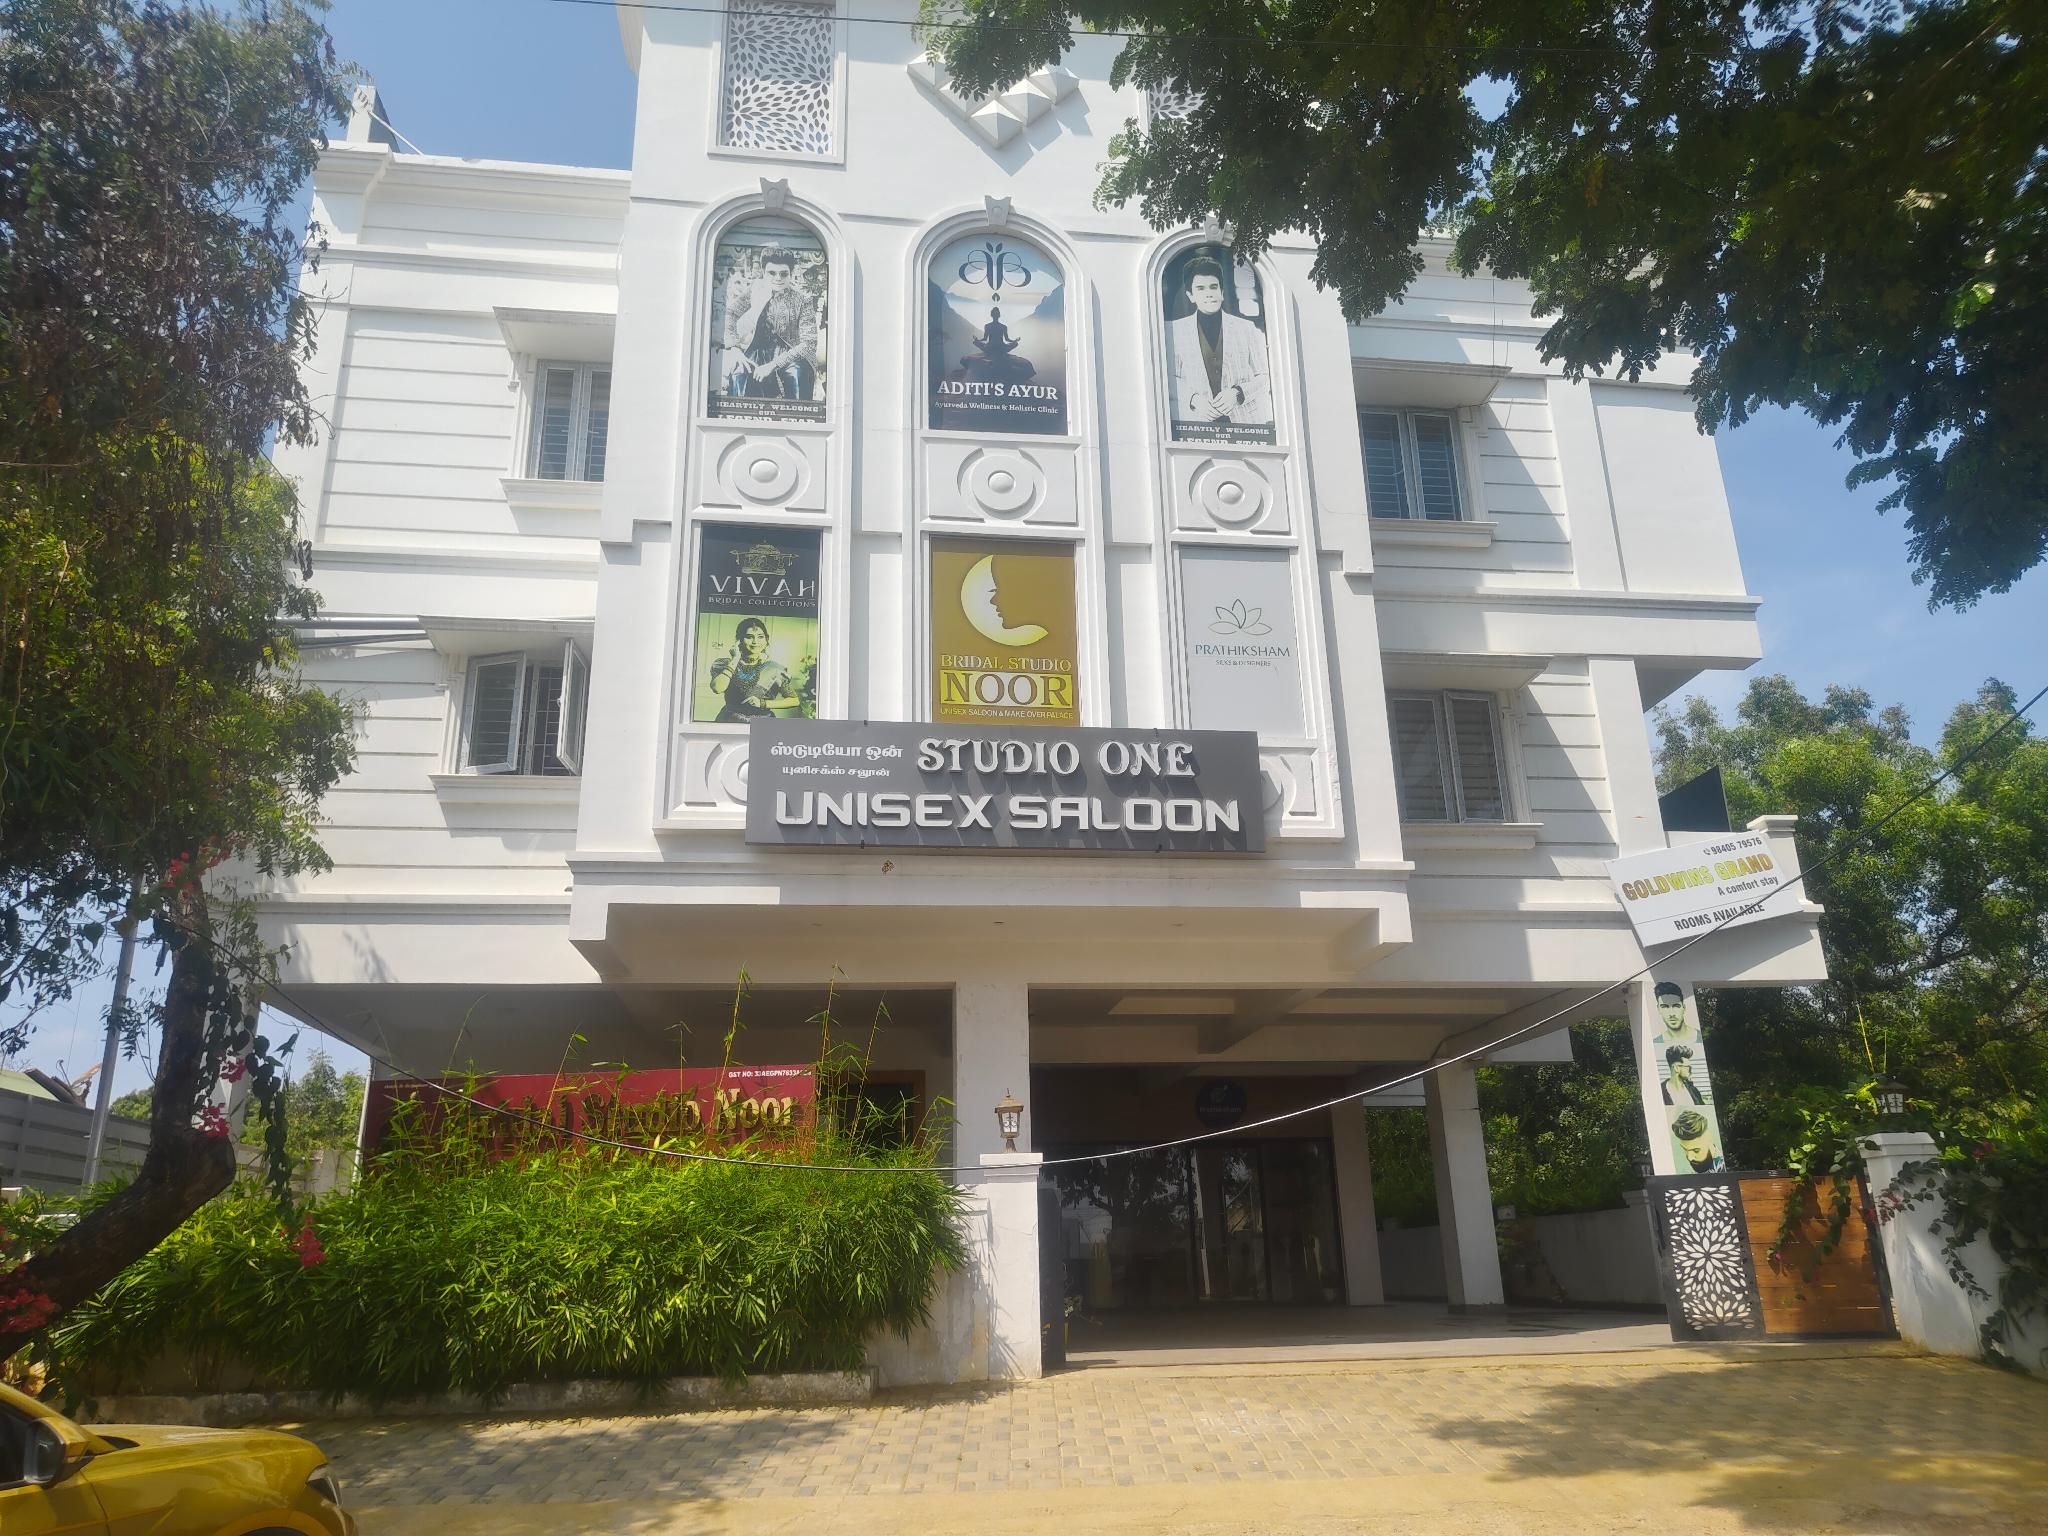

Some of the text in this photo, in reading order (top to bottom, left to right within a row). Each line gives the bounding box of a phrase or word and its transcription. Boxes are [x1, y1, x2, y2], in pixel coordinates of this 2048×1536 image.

[937, 381, 1058, 400] ADITI'S AYUR
[717, 402, 818, 412] HEARTILY WELCOME
[935, 402, 968, 410] Ayurveda
[969, 402, 1000, 410] Wellness
[1010, 404, 1036, 412] Holistic
[1038, 406, 1058, 414] Clinic
[710, 574, 815, 597] VIVAH
[708, 597, 816, 608] BRIDAL COLLECTIONS
[1196, 644, 1290, 656] PRATHIKSHAM
[941, 654, 1072, 672] BRIDAL STUDIO
[944, 672, 1070, 706] NOOR
[941, 708, 967, 716] UNISEX
[1004, 710, 1025, 718] MAKE
[770, 742, 904, 760] ஸ்டுடியோ ஒன்
[917, 738, 1195, 777] STUDIO ONE
[776, 790, 1240, 832] UNISEX SALOON
[1710, 837, 1762, 855] 98405 79576
[1622, 853, 1774, 901] GOLDWINS GRAND
[1718, 876, 1779, 896] A comfort stay
[1674, 914, 1712, 930] ROOMS
